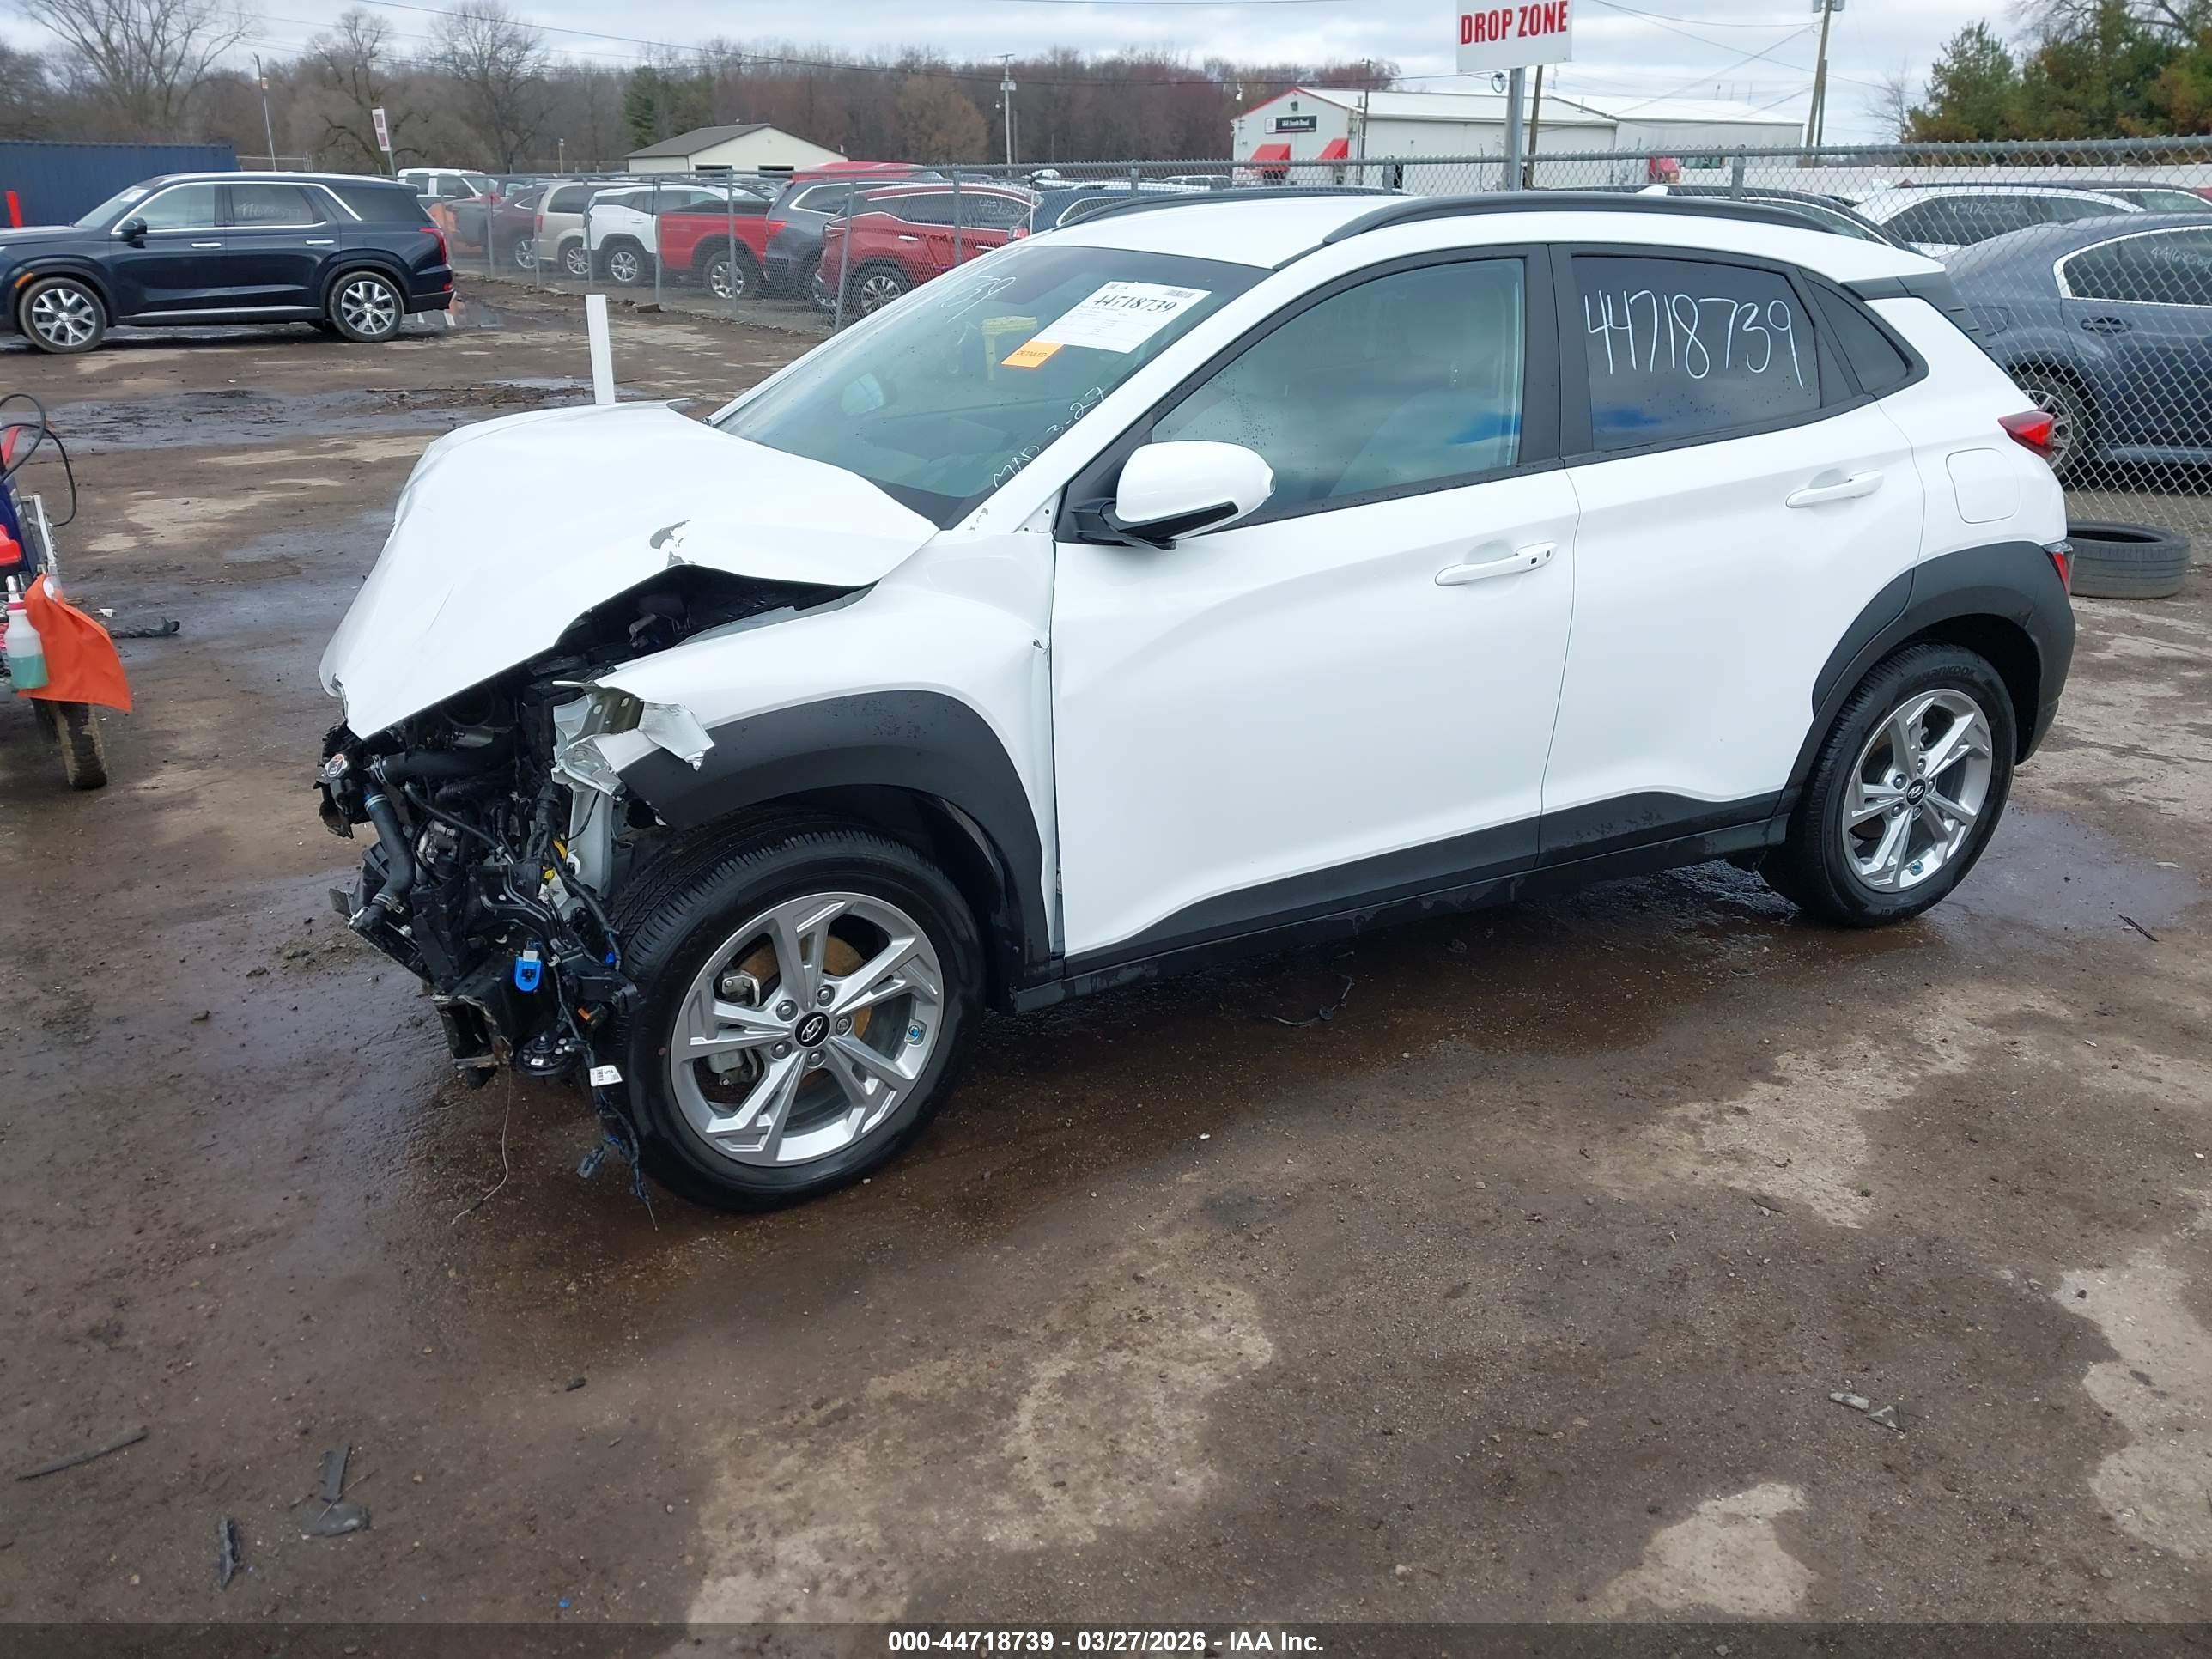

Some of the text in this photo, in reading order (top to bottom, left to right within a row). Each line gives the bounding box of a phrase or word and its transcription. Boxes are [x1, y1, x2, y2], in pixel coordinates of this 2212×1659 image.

[1461, 1, 1568, 45] DROP ZONE
[1092, 294, 1178, 313] 44718739
[1583, 289, 1805, 390] 44718739
[1045, 386, 1105, 434] 3-27
